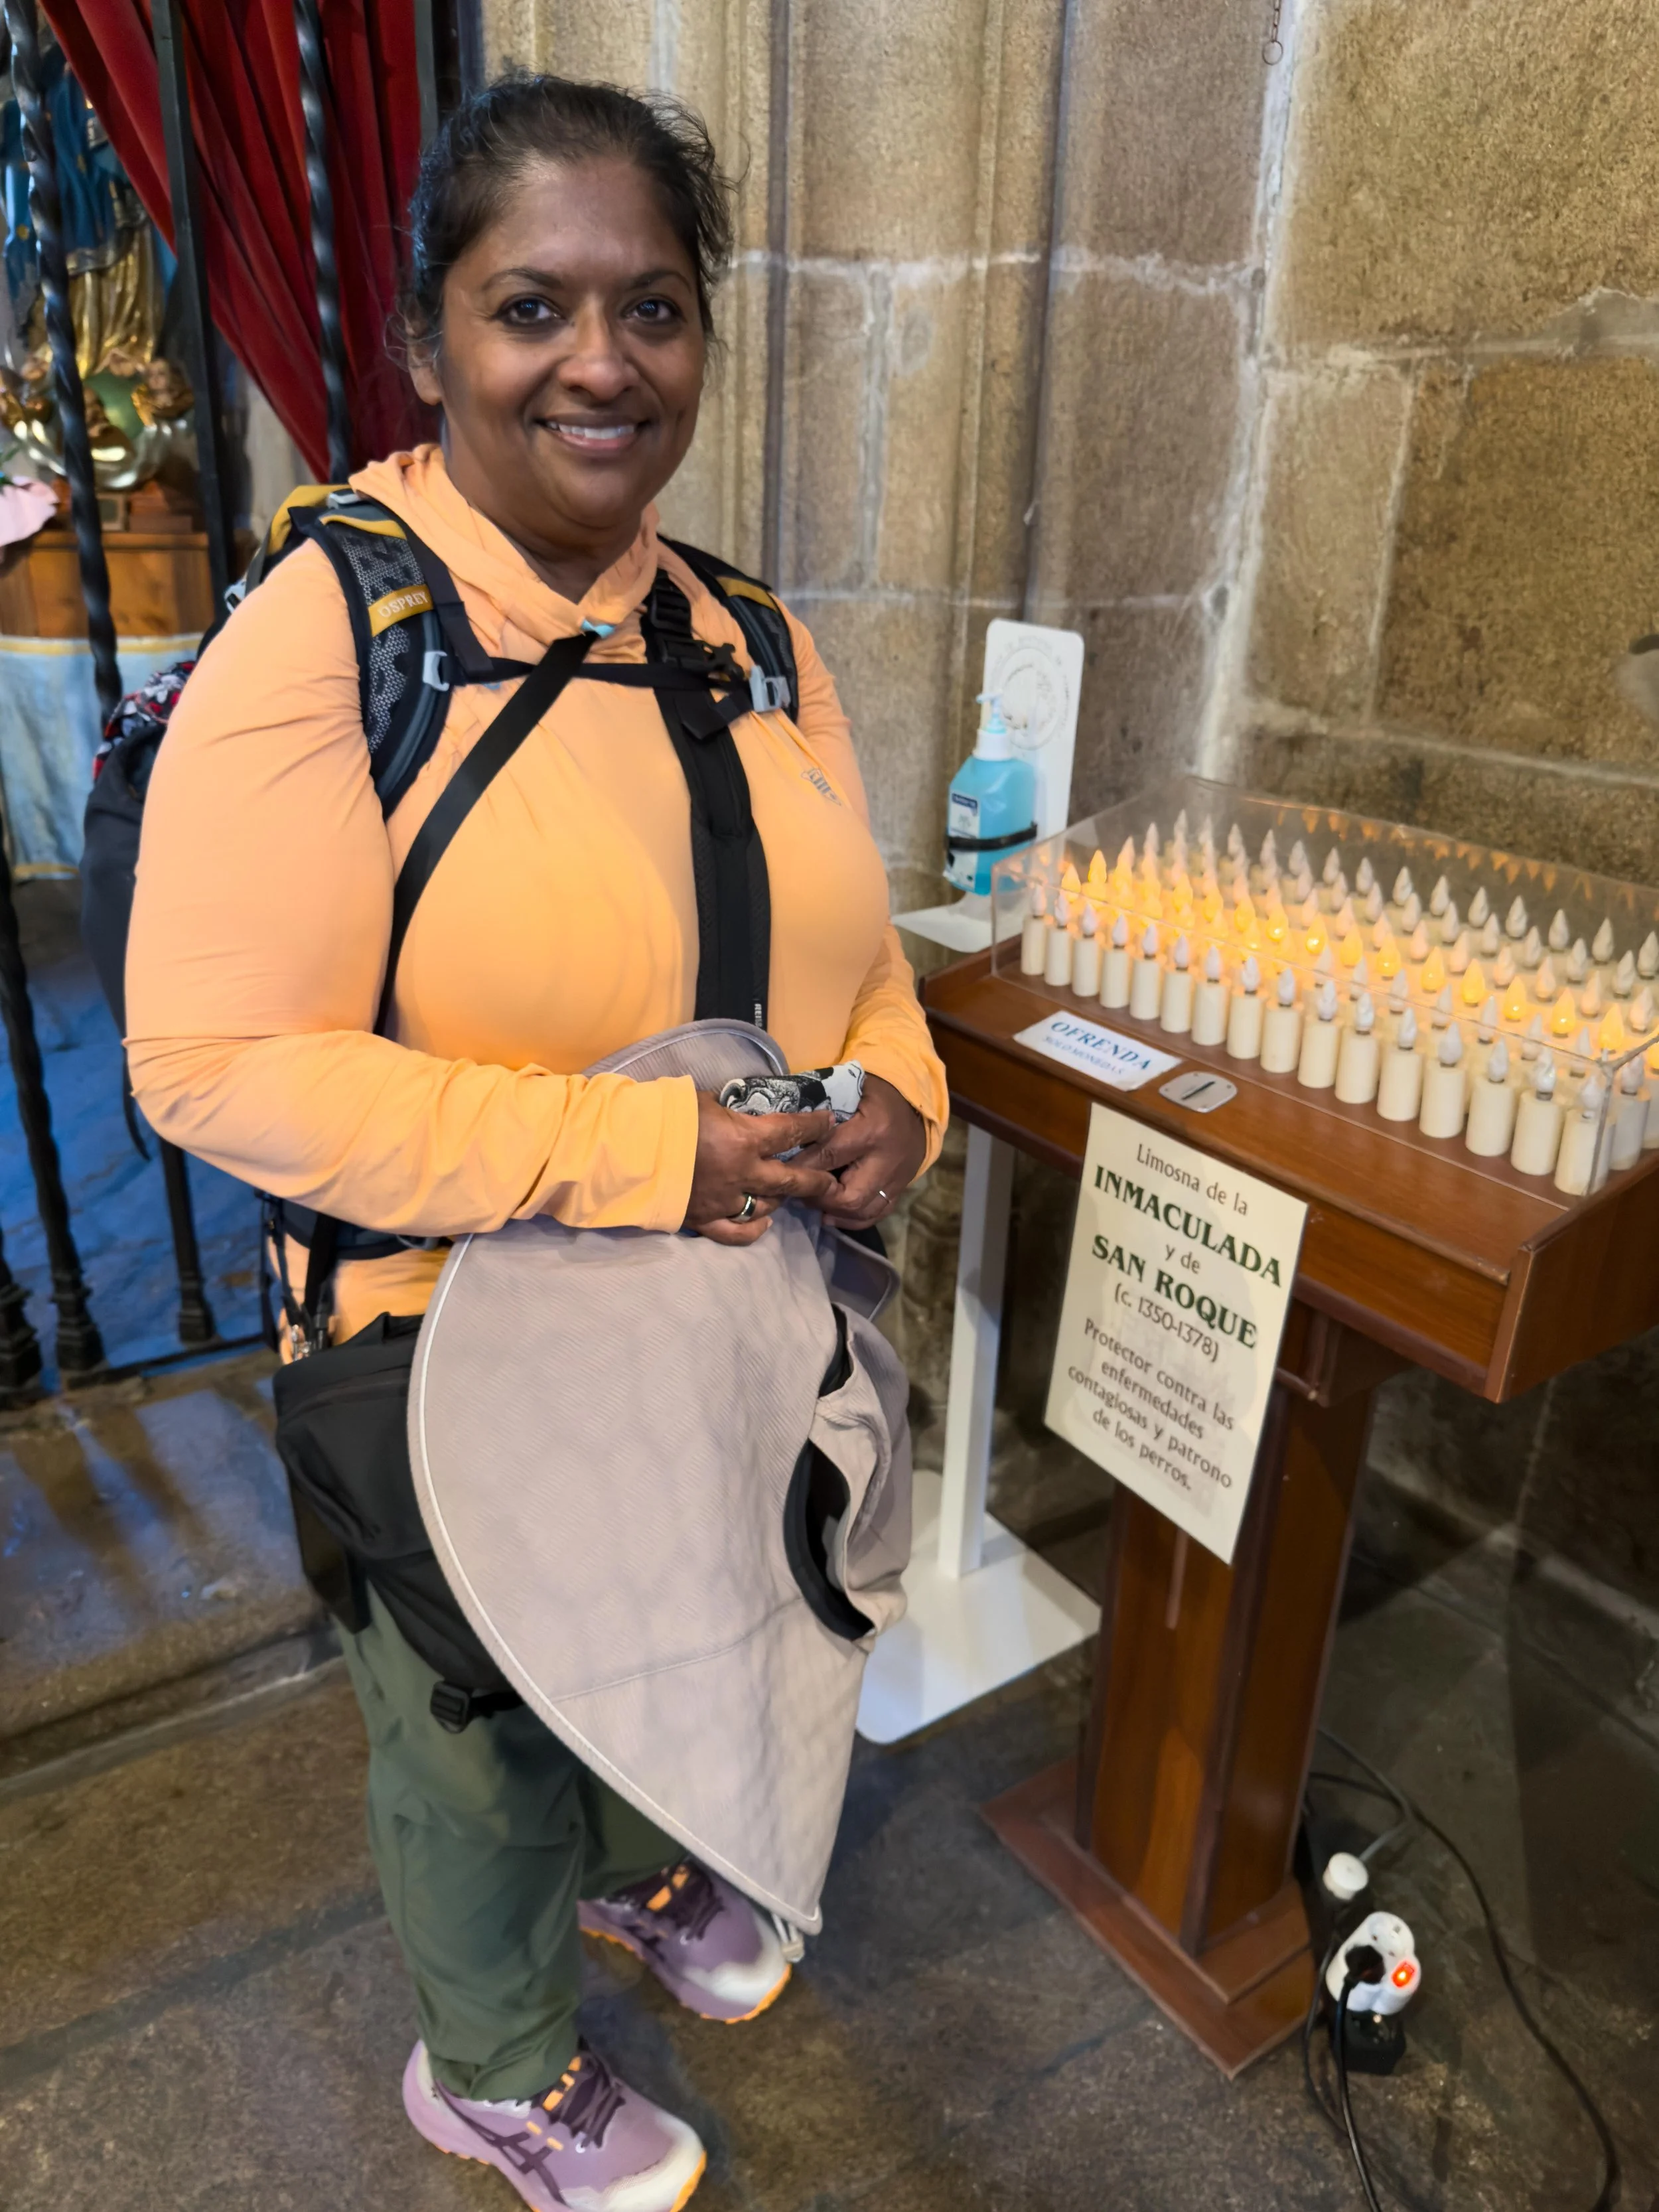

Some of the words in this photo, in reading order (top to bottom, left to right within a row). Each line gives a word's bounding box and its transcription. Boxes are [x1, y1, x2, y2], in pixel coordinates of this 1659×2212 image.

[378, 591, 429, 617] OSPREY
[1050, 1021, 1151, 1070] OFRENDA
[1137, 1143, 1200, 1192] Limosna
[1206, 1182, 1227, 1205] de
[1234, 1193, 1248, 1216] la
[1094, 1165, 1281, 1288] INMACULADA
[1165, 1244, 1175, 1261] y
[1181, 1252, 1200, 1274] de
[1092, 1234, 1146, 1283] SAN
[1154, 1269, 1258, 1349] ROQUE
[1114, 1282, 1131, 1307] (c.
[1137, 1297, 1219, 1363] 1350-1378)
[1084, 1317, 1153, 1374] Protector
[1157, 1370, 1206, 1412] contra
[1212, 1402, 1233, 1430] las
[1102, 1361, 1204, 1439] enfermedades
[1068, 1365, 1148, 1429] contagiosas
[1154, 1423, 1164, 1441] y
[1168, 1436, 1232, 1489] patrono
[1092, 1408, 1110, 1432] de
[1115, 1421, 1135, 1448] los
[1138, 1443, 1192, 1491] perros.
